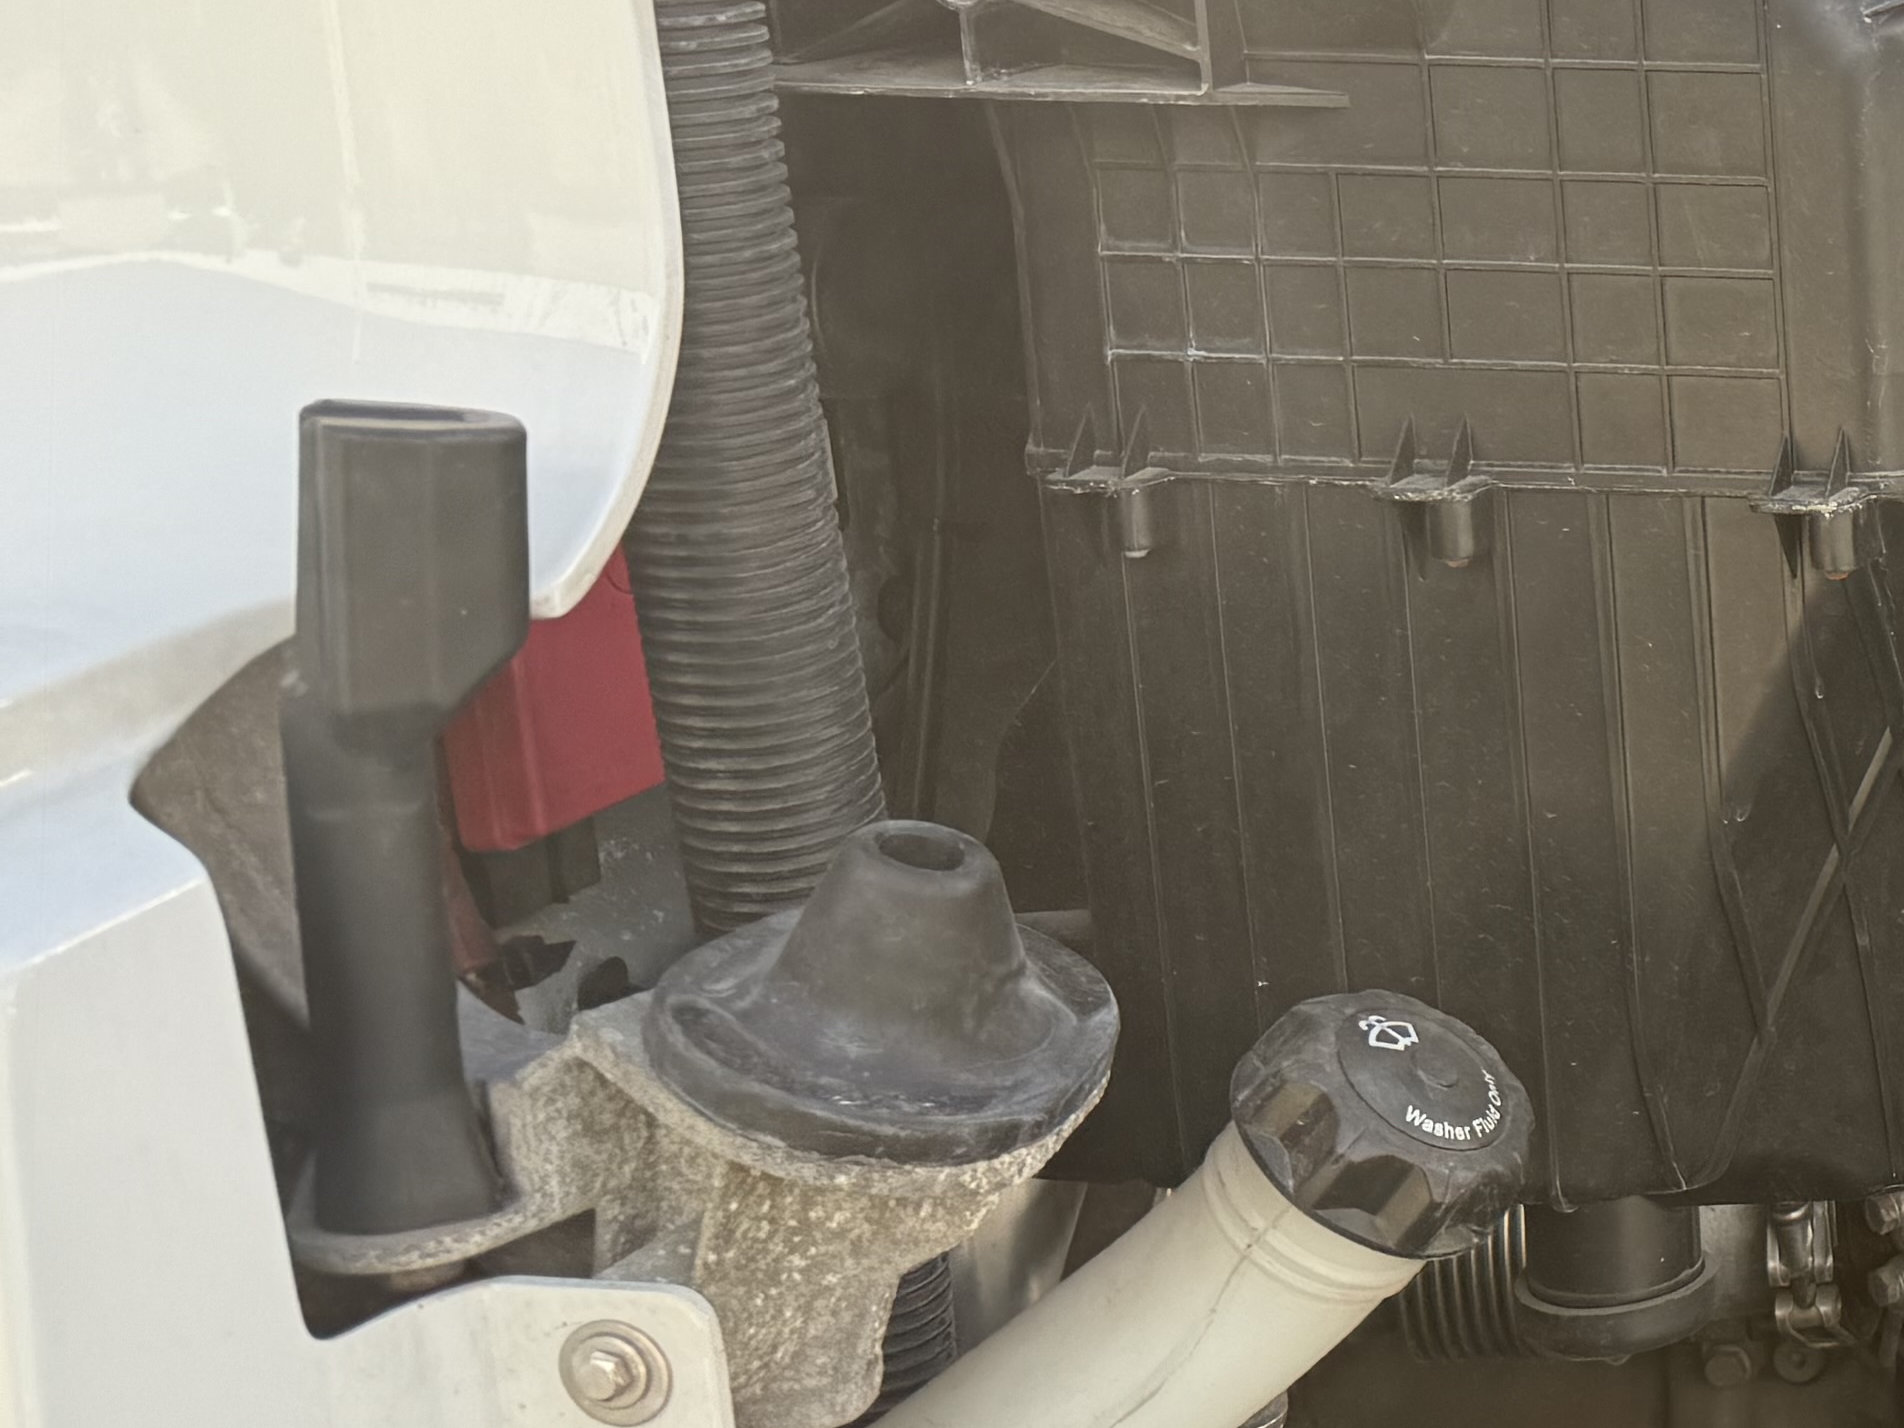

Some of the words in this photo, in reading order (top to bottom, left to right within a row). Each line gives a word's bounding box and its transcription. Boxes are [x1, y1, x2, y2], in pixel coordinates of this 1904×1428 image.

[1480, 1065, 1503, 1107] Only
[1405, 1104, 1472, 1142] Washer
[1472, 1104, 1503, 1140] Fluid
